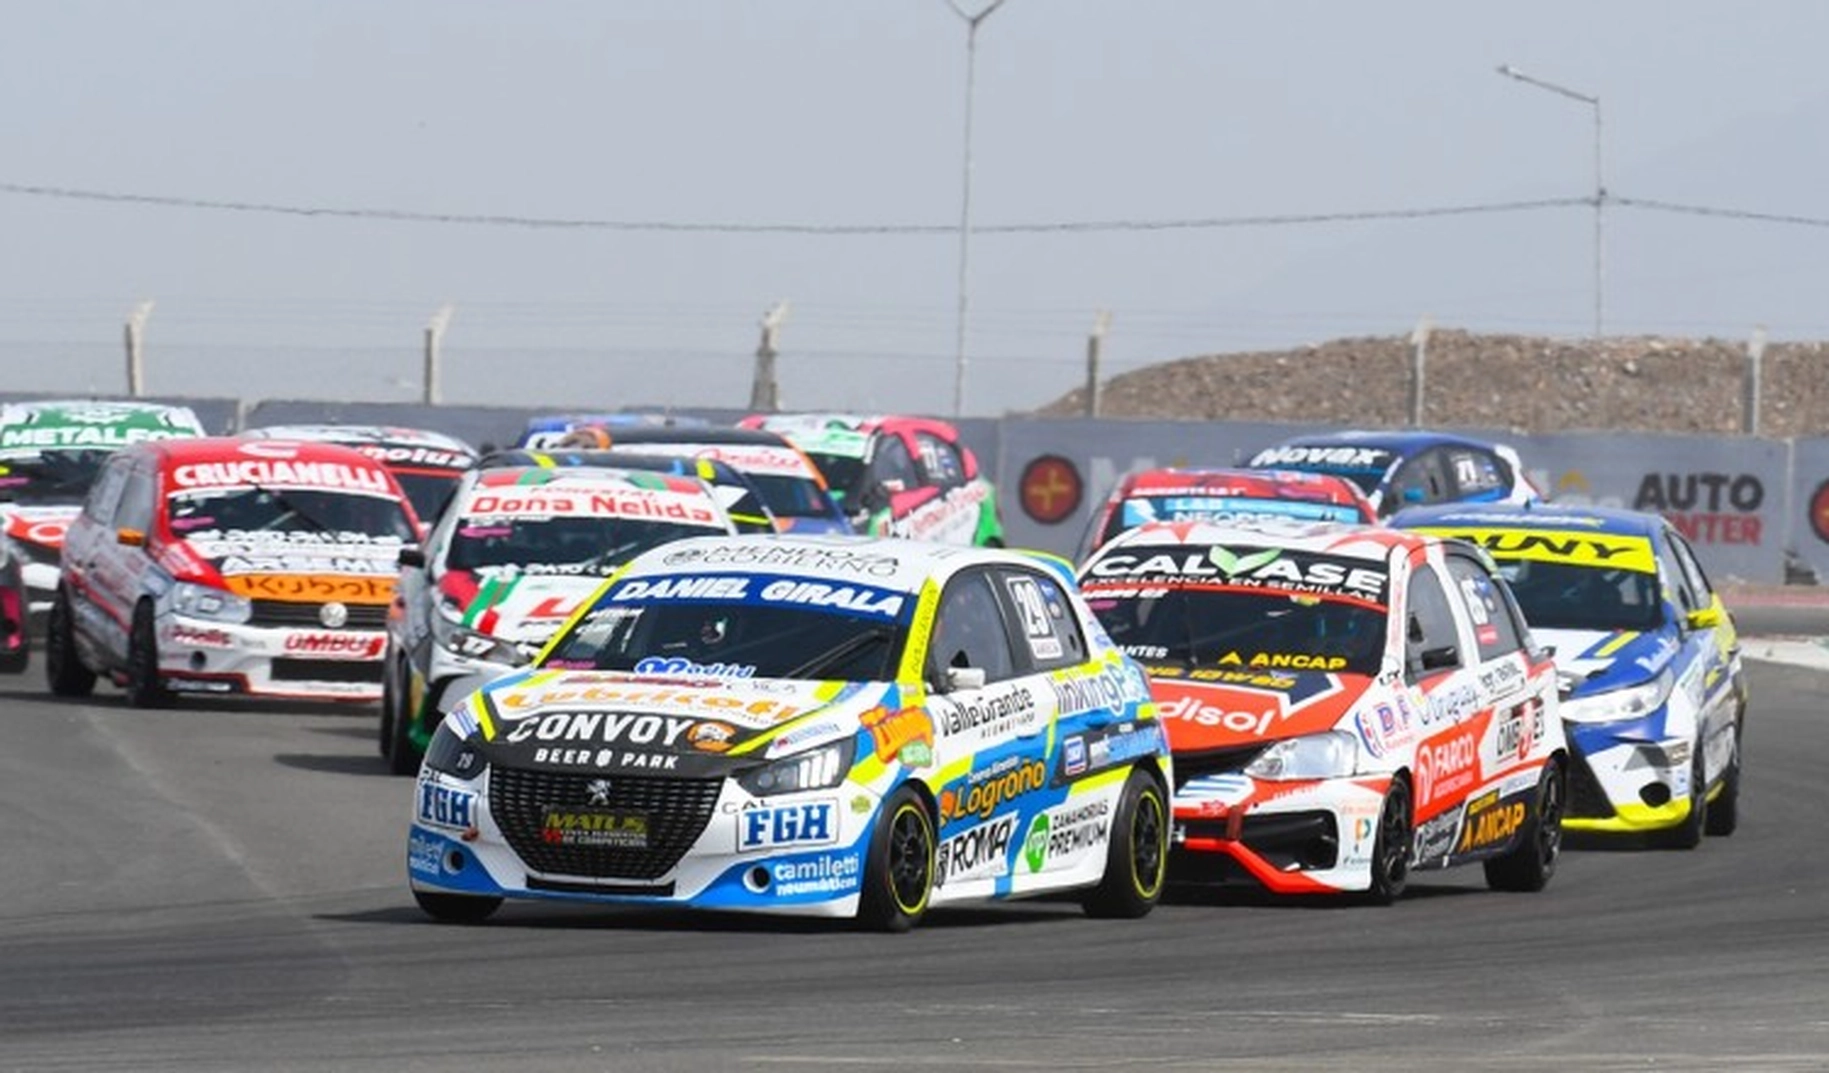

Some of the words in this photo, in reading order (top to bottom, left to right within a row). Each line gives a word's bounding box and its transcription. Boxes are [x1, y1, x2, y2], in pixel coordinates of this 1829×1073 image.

[173, 461, 390, 492] CRUCIANELLI
[1634, 473, 1764, 511] AUTO
[246, 576, 394, 597] Kubot
[1091, 545, 1388, 593] CALVASE
[612, 577, 750, 601] DANIEL
[760, 580, 904, 617] GIRALA
[1083, 575, 1216, 586] EXCELENCIA
[1219, 576, 1255, 587] EN
[1266, 579, 1379, 602] SEMILLAS
[1250, 652, 1348, 670] ANCAP
[506, 712, 694, 746] CONVOY
[534, 748, 590, 764] BEER
[621, 752, 678, 769] PARK
[420, 782, 472, 827] FGH
[954, 757, 1046, 819] Logroño
[742, 804, 831, 846] FGH
[1049, 820, 1108, 859] PREMIUM
[774, 852, 859, 880] camiletti
[951, 817, 1014, 877] ROMA
